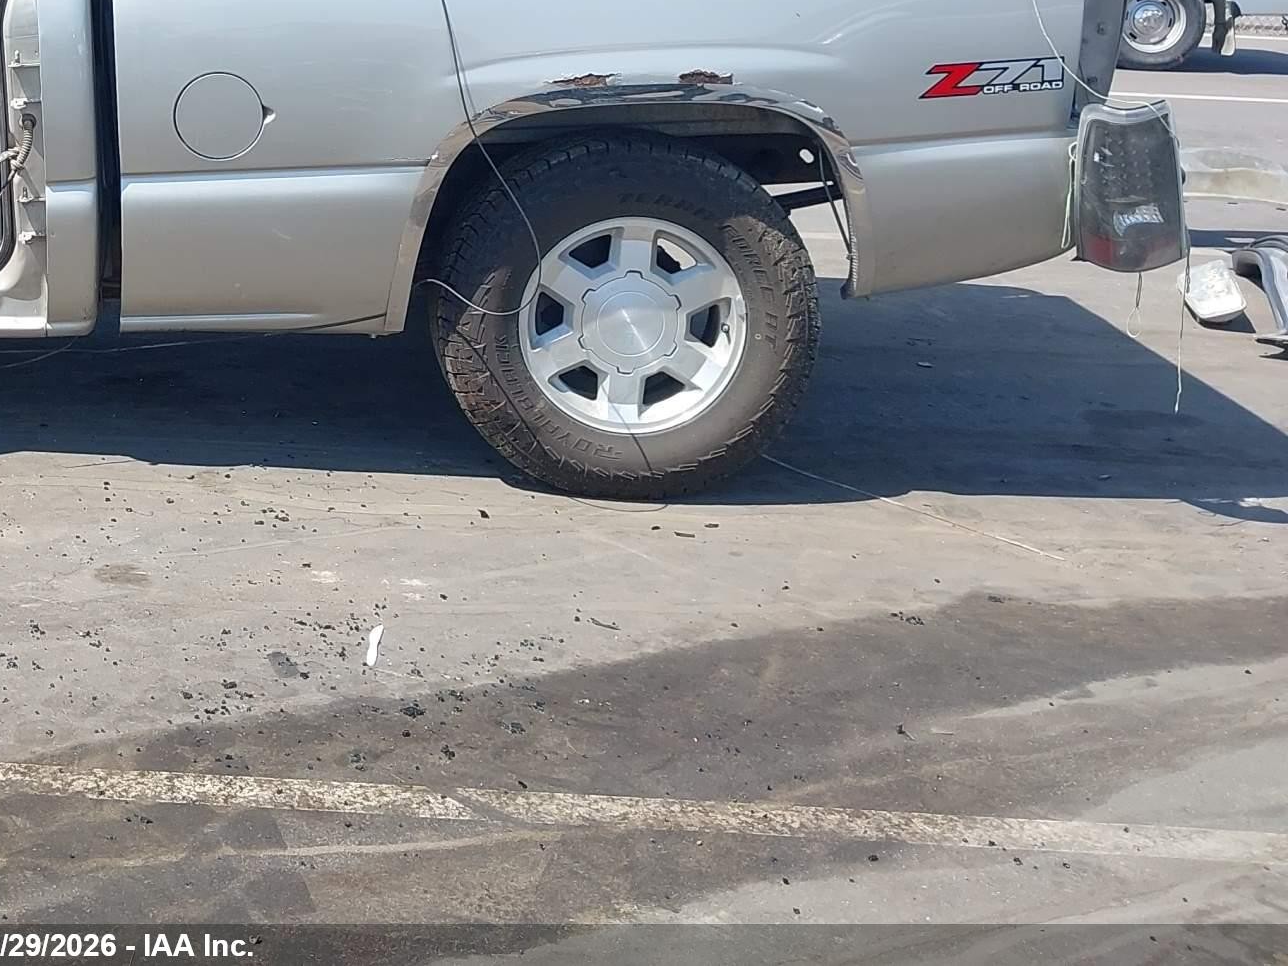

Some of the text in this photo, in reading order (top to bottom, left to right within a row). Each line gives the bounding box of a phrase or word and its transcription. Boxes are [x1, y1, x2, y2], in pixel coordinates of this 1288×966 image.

[918, 56, 1065, 100] Z71
[983, 81, 1063, 94] OFF ROAD
